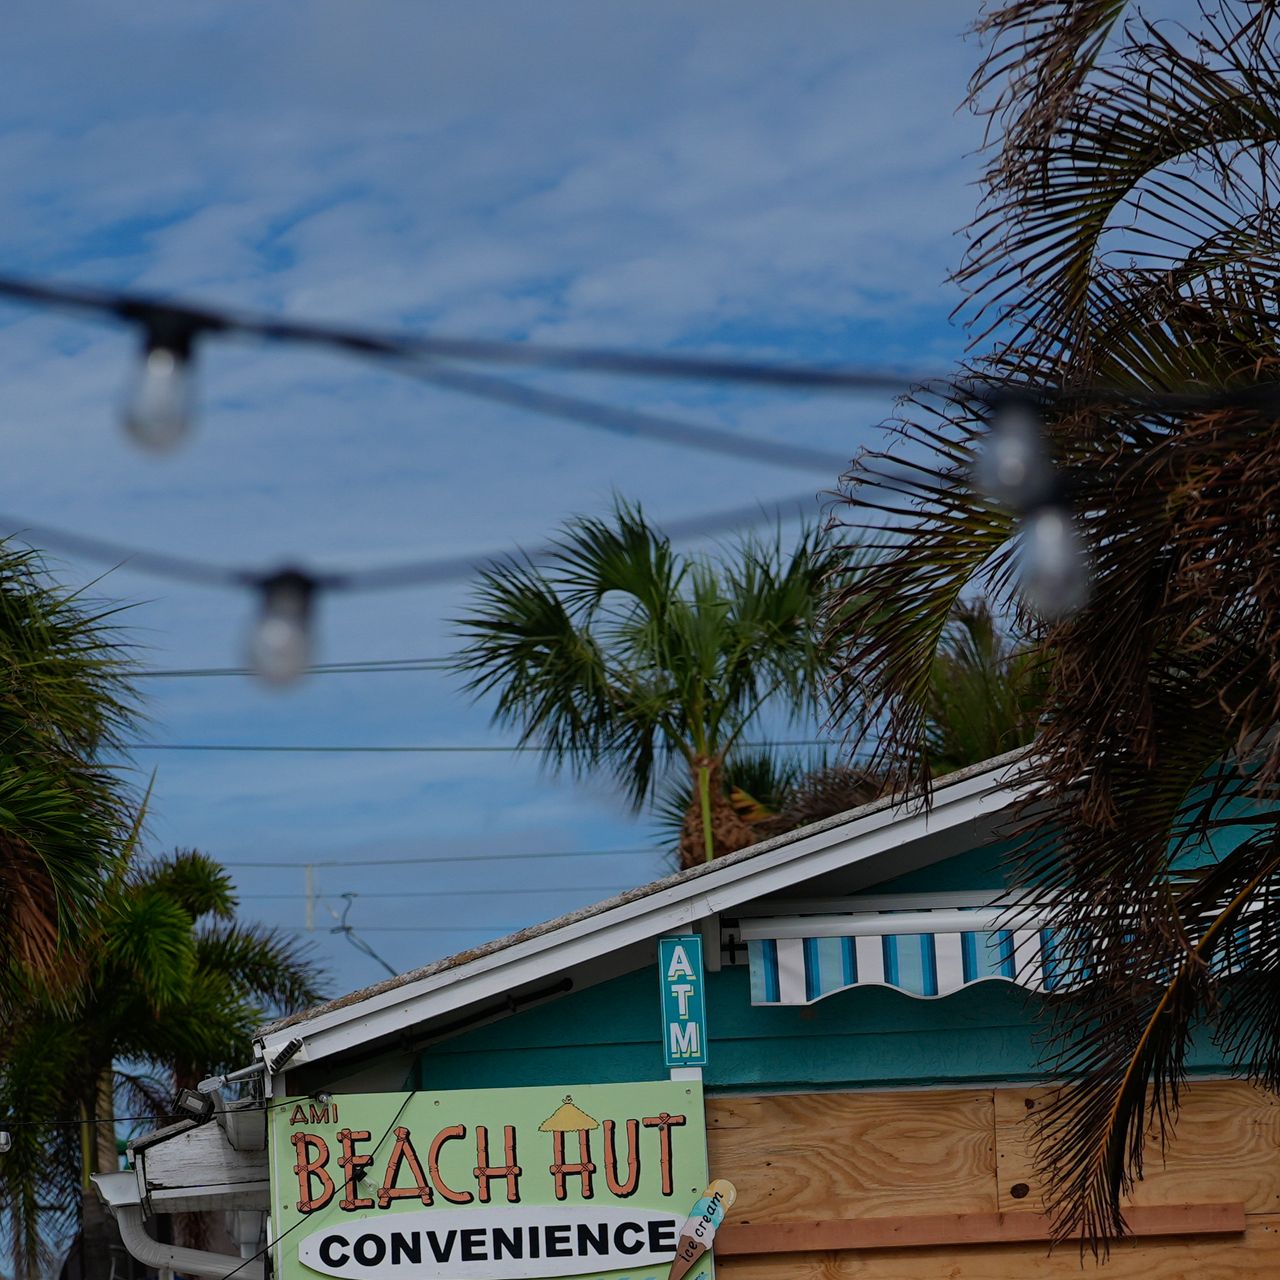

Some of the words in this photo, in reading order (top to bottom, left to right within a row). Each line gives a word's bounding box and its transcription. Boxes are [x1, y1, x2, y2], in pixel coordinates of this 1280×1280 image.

[666, 945, 701, 1058] ATM
[290, 1103, 339, 1125] AMI
[290, 1123, 522, 1214] BEACH
[549, 1112, 687, 1200] HUT
[319, 1219, 677, 1268] CONVENIENCE
[679, 1240, 698, 1263] ice
[695, 1190, 724, 1238] cream
